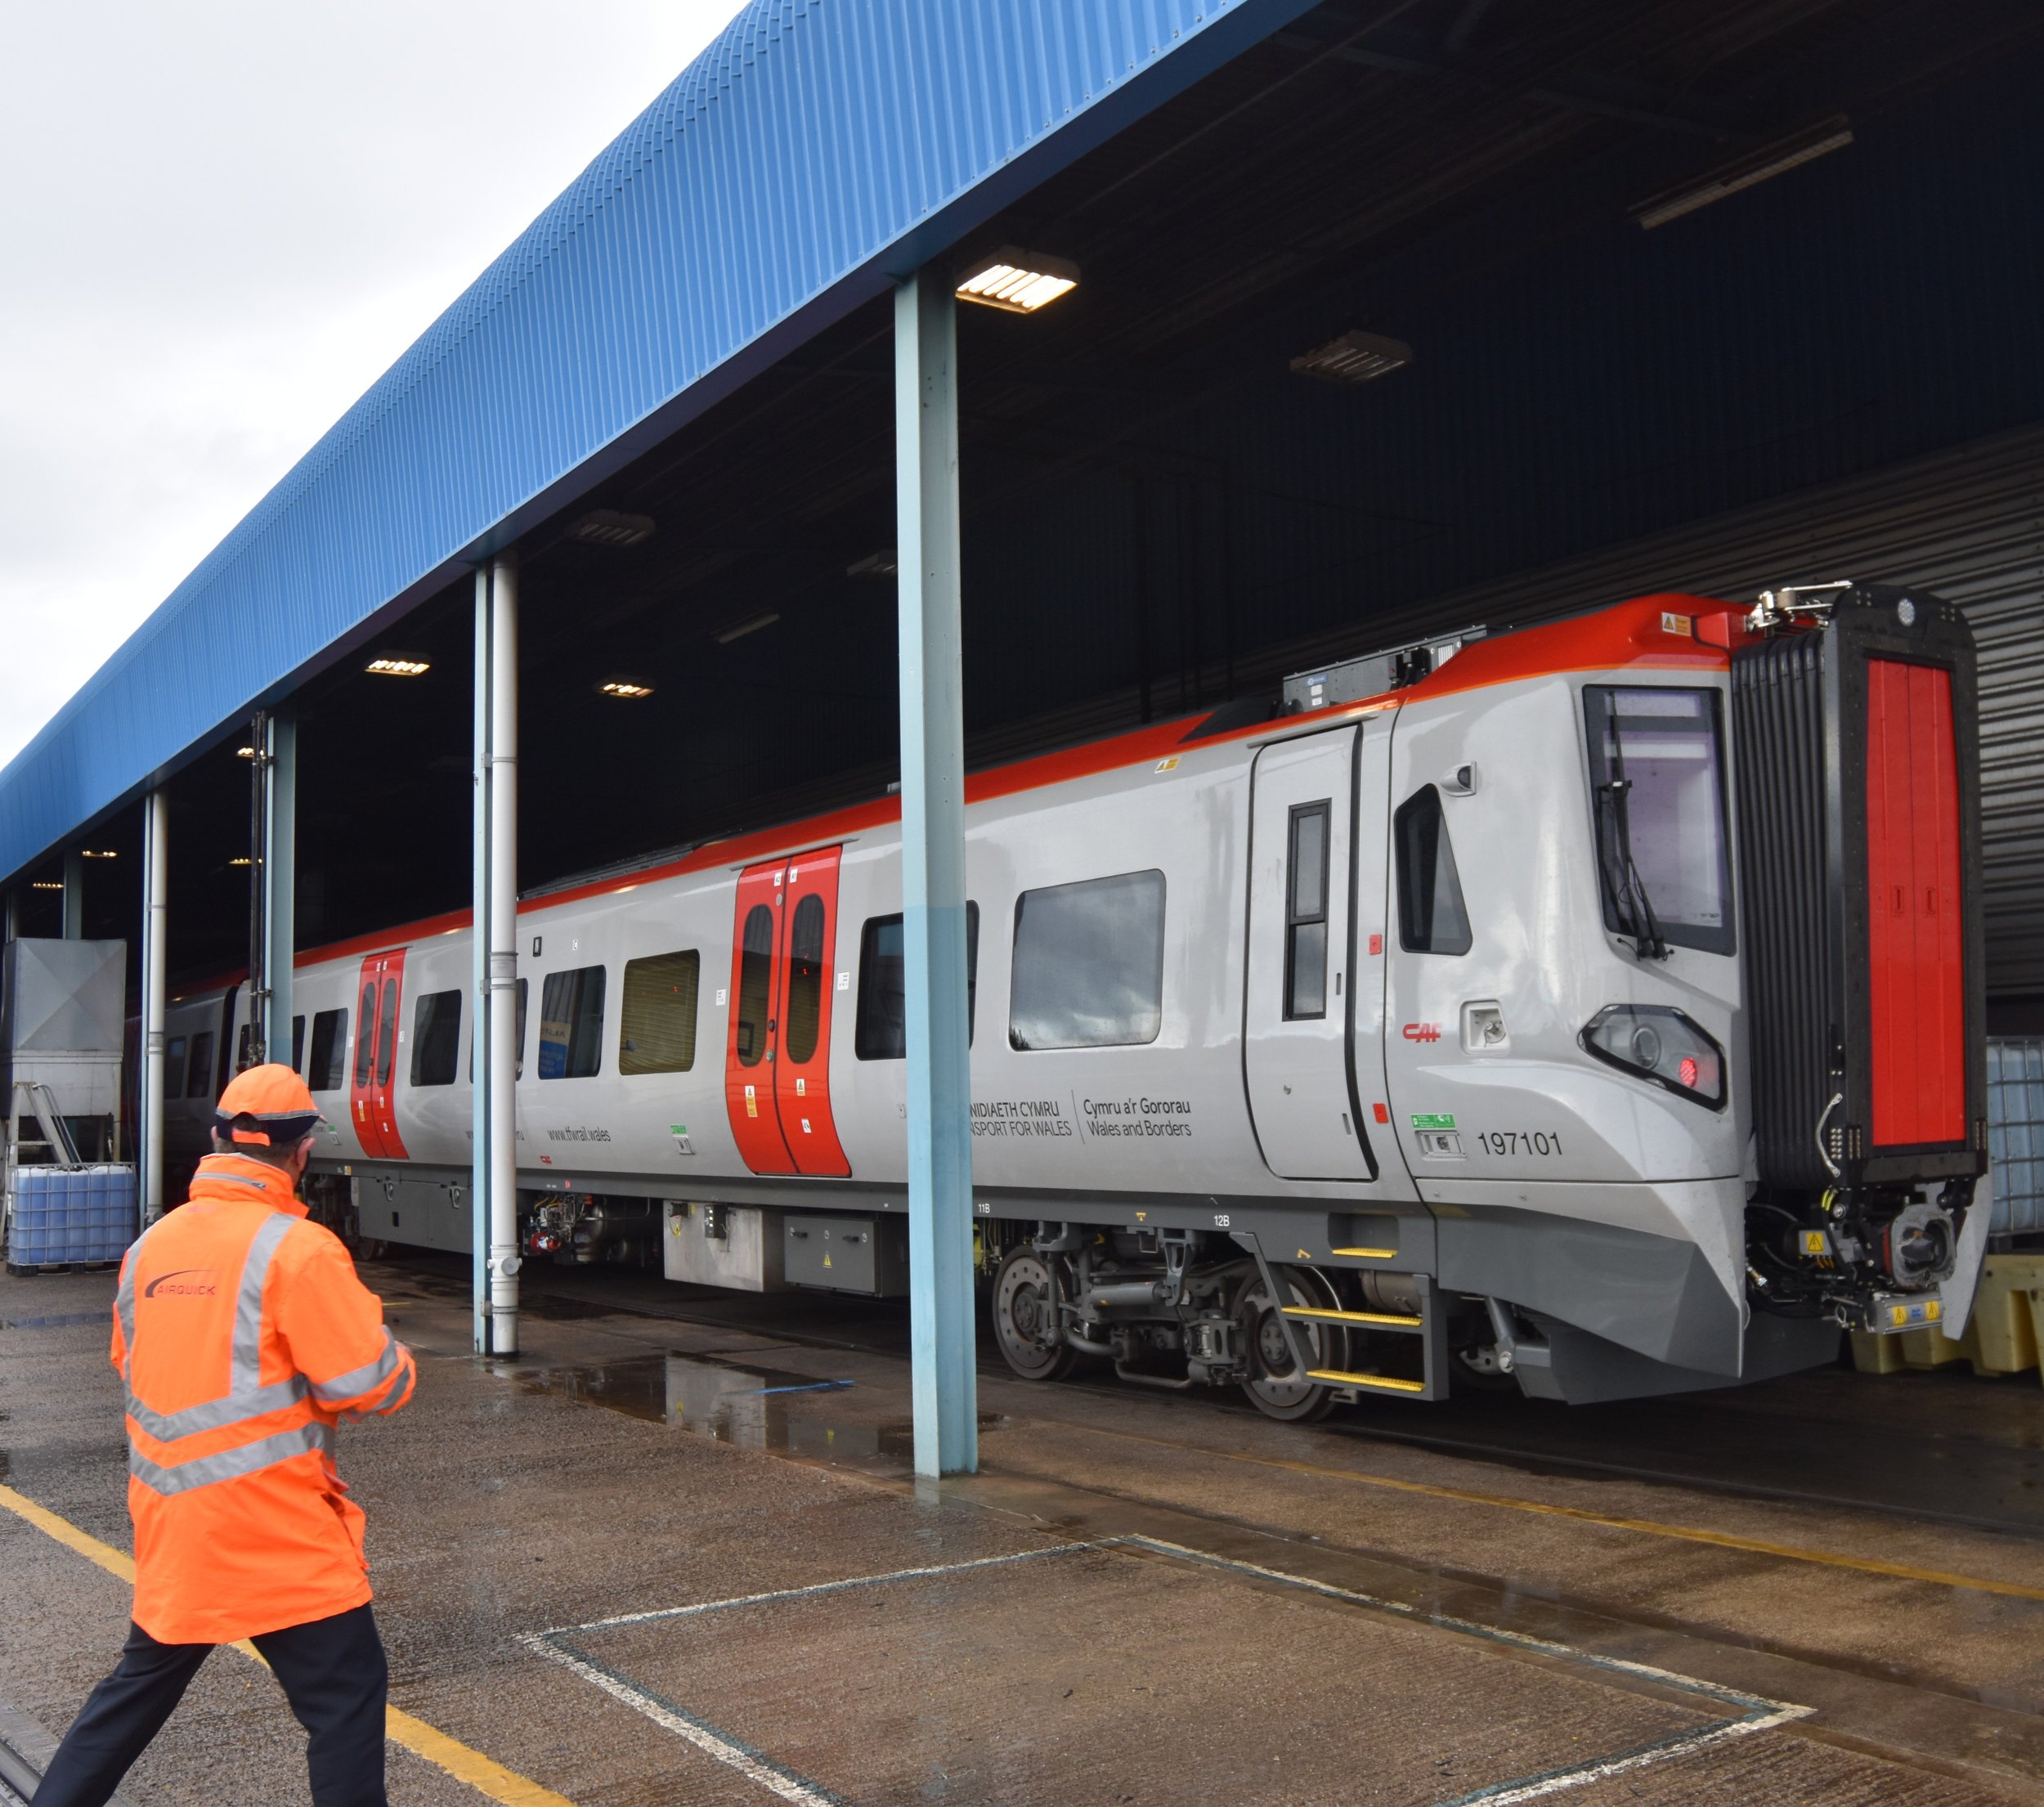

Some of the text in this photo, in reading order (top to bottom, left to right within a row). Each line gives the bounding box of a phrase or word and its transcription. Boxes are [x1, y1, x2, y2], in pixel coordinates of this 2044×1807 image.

[1402, 1022, 1442, 1043] CAF
[970, 1101, 1060, 1118] NIDIAETH CYMRU
[1083, 1097, 1191, 1119] Cymru a'r Gororau
[547, 1126, 612, 1142] www.tfwrail.wales
[970, 1120, 1072, 1137] NSPORT FOR WALES
[1087, 1120, 1192, 1137] Wales and Borders
[1477, 1132, 1562, 1155] 197101
[978, 1203, 991, 1213] 11B
[1213, 1215, 1230, 1227] 12B
[156, 1285, 216, 1295] AIRQUICK
